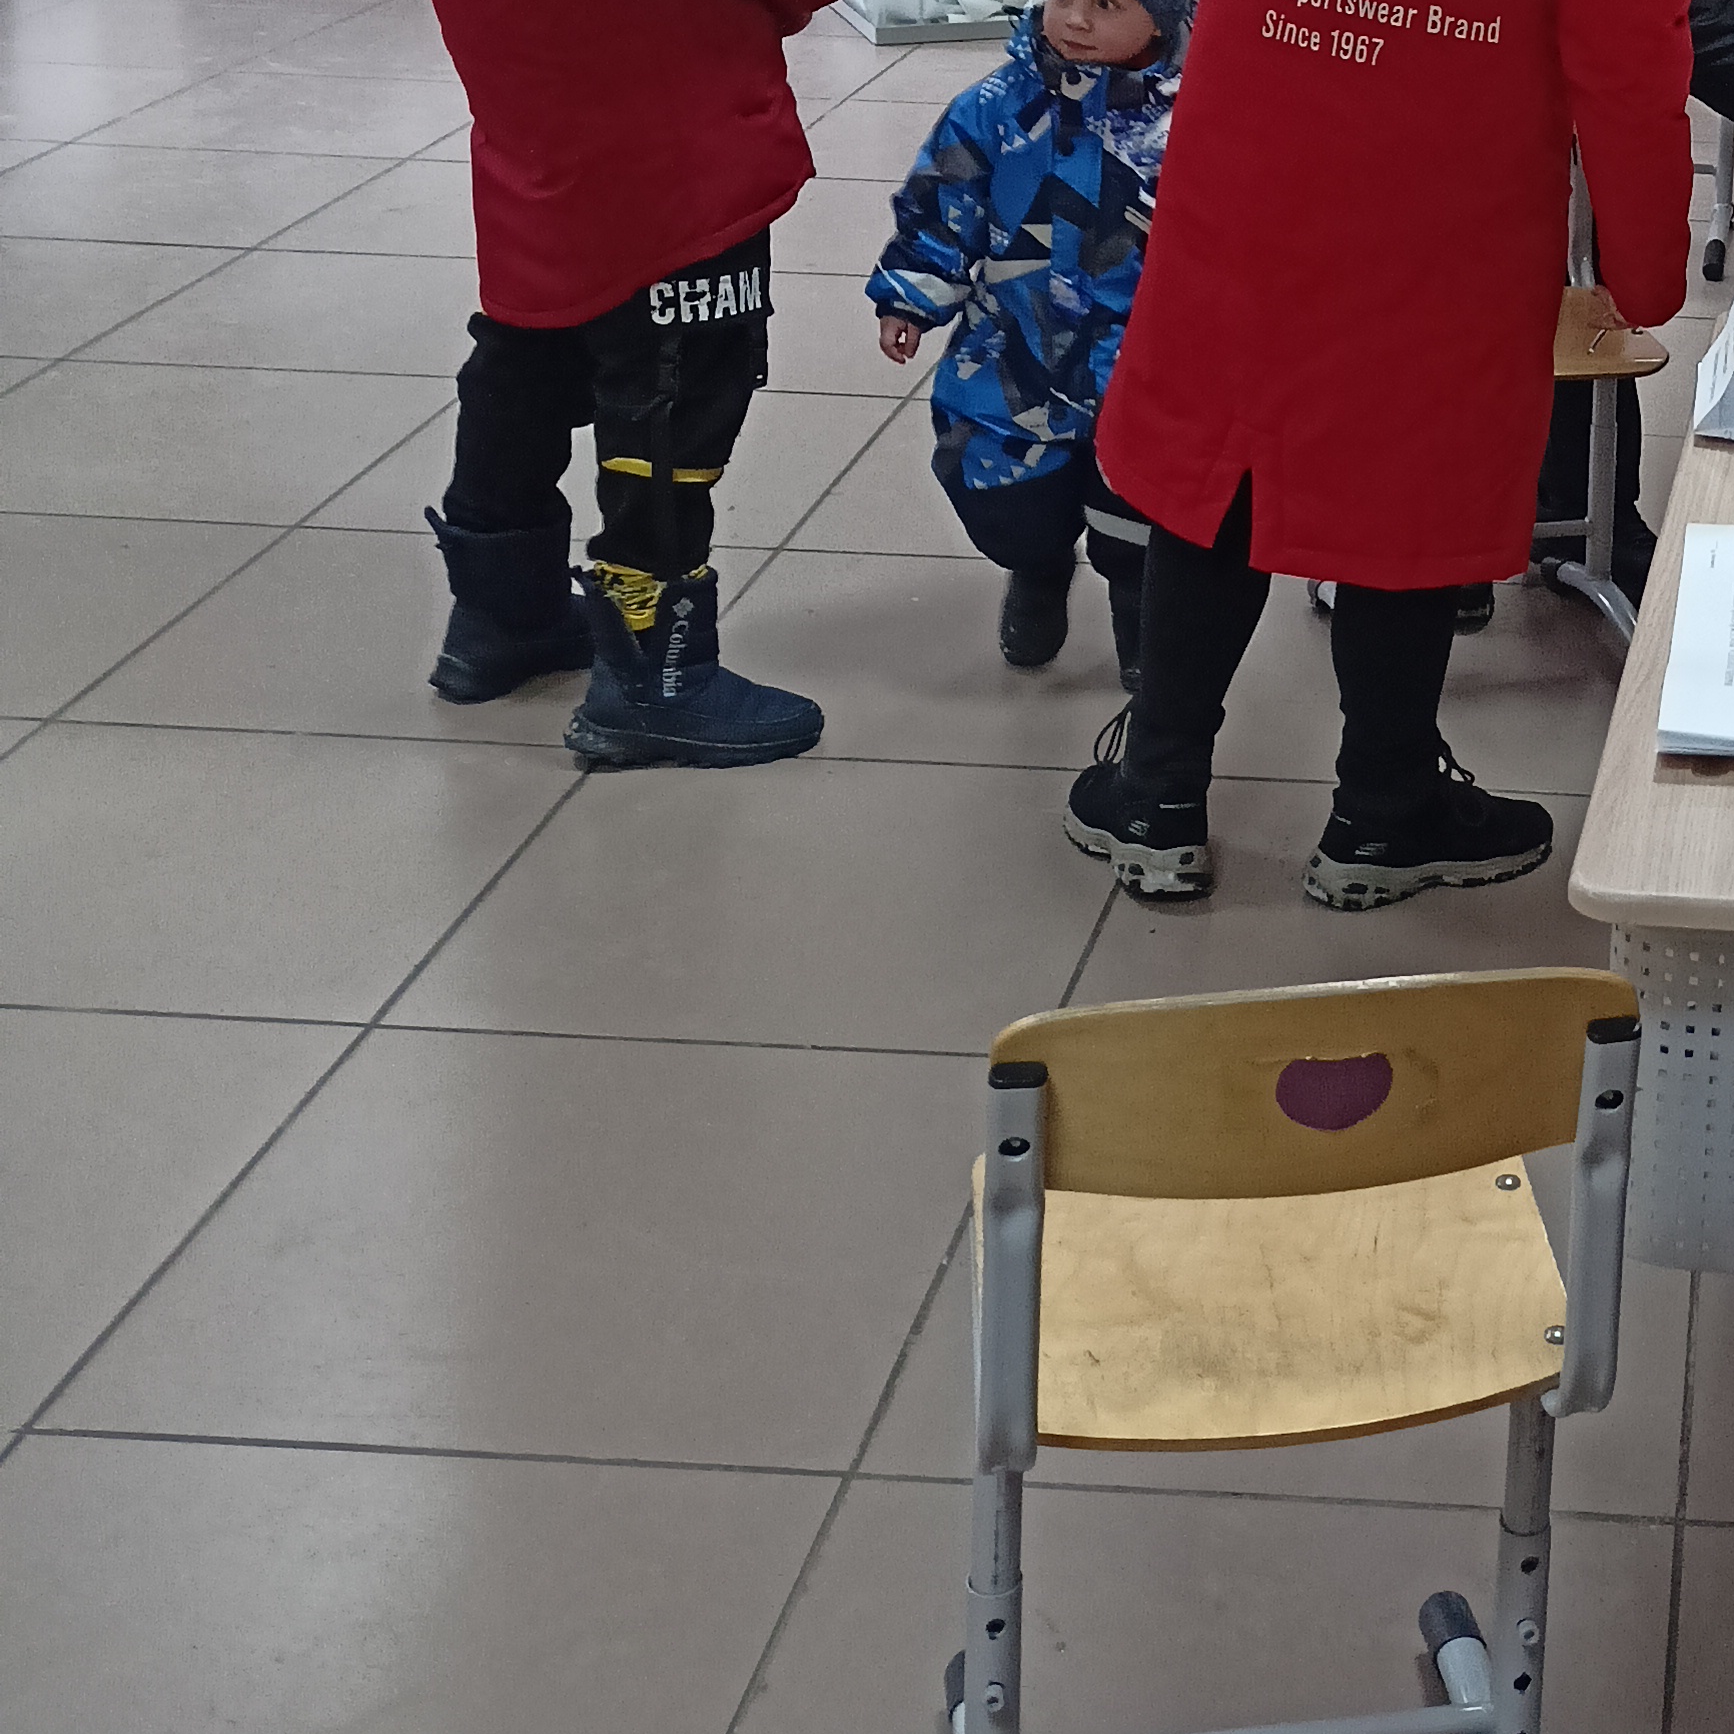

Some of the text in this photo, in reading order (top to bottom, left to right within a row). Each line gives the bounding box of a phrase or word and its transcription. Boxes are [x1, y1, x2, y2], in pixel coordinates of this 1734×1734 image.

[1261, 8, 1385, 66] Since 1967
[1426, 4, 1502, 44] Brand
[649, 266, 762, 326] CHAM
